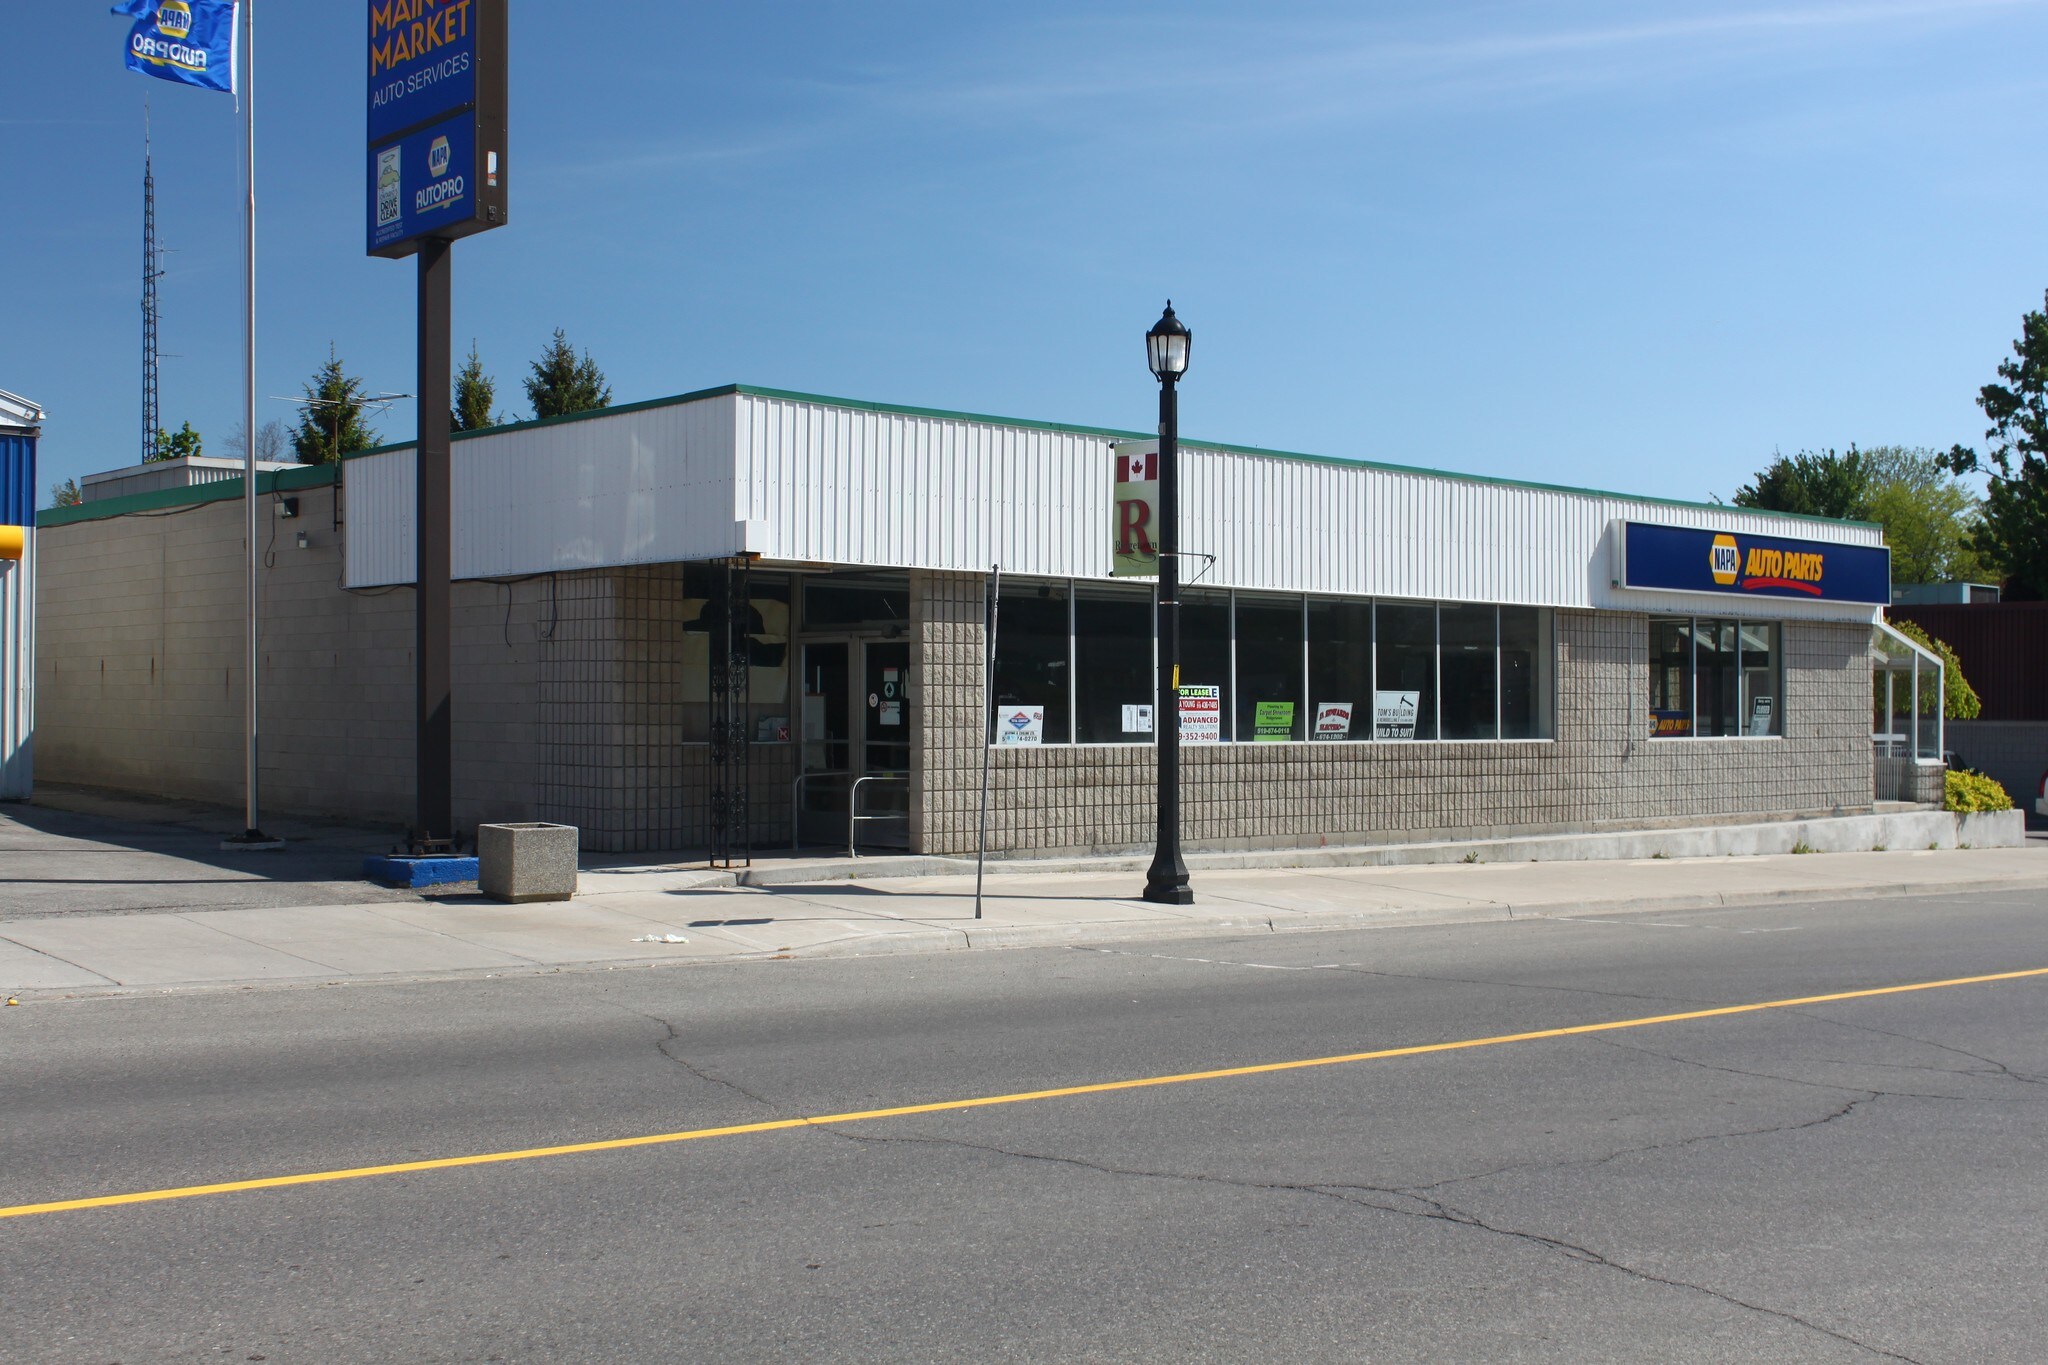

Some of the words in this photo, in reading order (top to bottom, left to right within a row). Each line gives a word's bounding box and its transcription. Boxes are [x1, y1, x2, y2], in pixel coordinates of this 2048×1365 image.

[372, 0, 471, 77] MARKET
[372, 80, 405, 109] AUTO
[407, 51, 470, 93] SERVICES
[431, 145, 449, 168] NAPA
[416, 175, 464, 209] AUTOPRO
[380, 196, 398, 212] DRIVE
[380, 207, 398, 221] CLEAN
[1117, 499, 1157, 555] R
[1115, 540, 1158, 551] Rgetn
[1714, 547, 1736, 571] NAPA
[1745, 548, 1783, 579] AUTO
[1783, 551, 1824, 582] PARTS
[1190, 688, 1210, 696] LEASE
[1182, 716, 1219, 724] ADVANCED
[1377, 708, 1392, 717] TOM'S
[1376, 727, 1391, 738] UILD
[1391, 727, 1399, 738] TO
[1399, 727, 1413, 738] SUIT
[1657, 719, 1675, 731] AUTO
[1178, 732, 1218, 740] 9-352-9400
